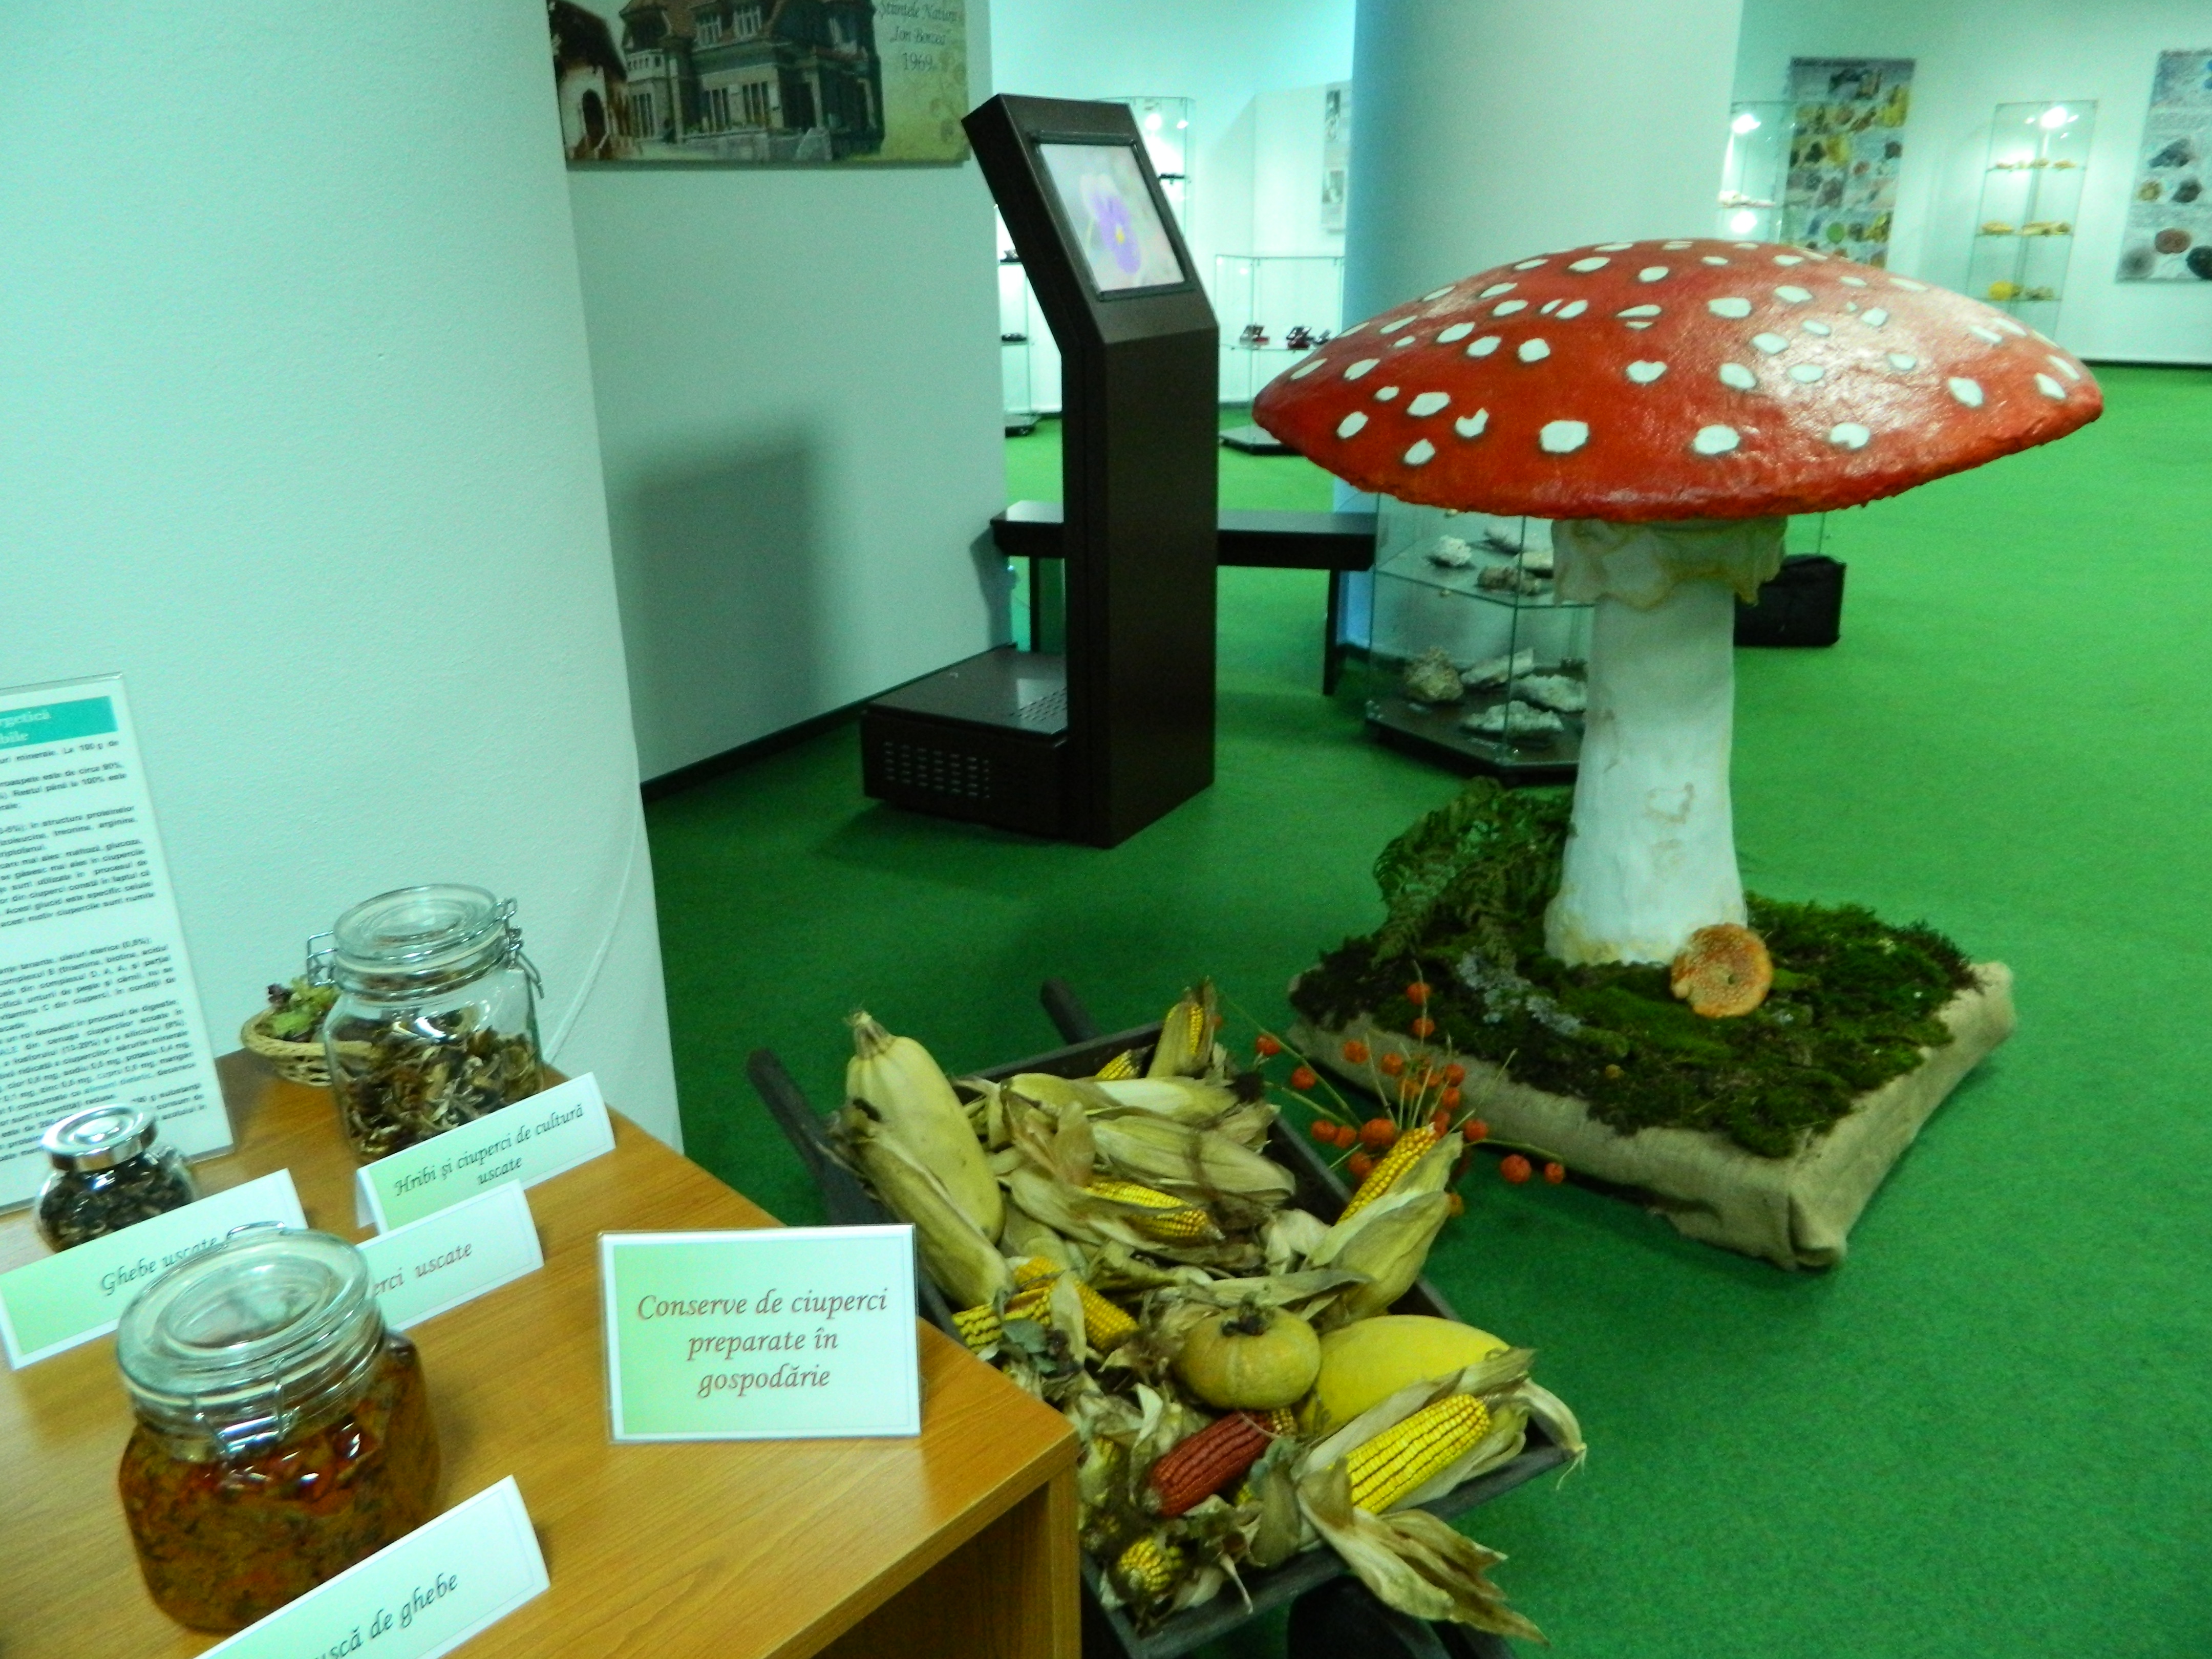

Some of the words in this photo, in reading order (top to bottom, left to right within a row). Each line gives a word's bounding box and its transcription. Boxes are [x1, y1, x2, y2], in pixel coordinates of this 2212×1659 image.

[393, 1166, 437, 1197] Hribi
[441, 1157, 453, 1180] și
[457, 1133, 512, 1169] ciuperci
[516, 1125, 530, 1144] de
[535, 1102, 584, 1137] cultură
[477, 1156, 522, 1186] uscate
[101, 1257, 157, 1296] Ghebe
[372, 1267, 406, 1298] erci
[415, 1243, 473, 1278] uscate
[638, 1294, 747, 1321] Conserve
[755, 1288, 783, 1315] de
[791, 1287, 889, 1320] ciuperci
[686, 1331, 805, 1362] preparate
[814, 1327, 838, 1350] în
[697, 1363, 831, 1398] gospodărie
[314, 1625, 364, 1659] scă
[370, 1608, 393, 1639] de
[400, 1572, 458, 1629] ghebe
